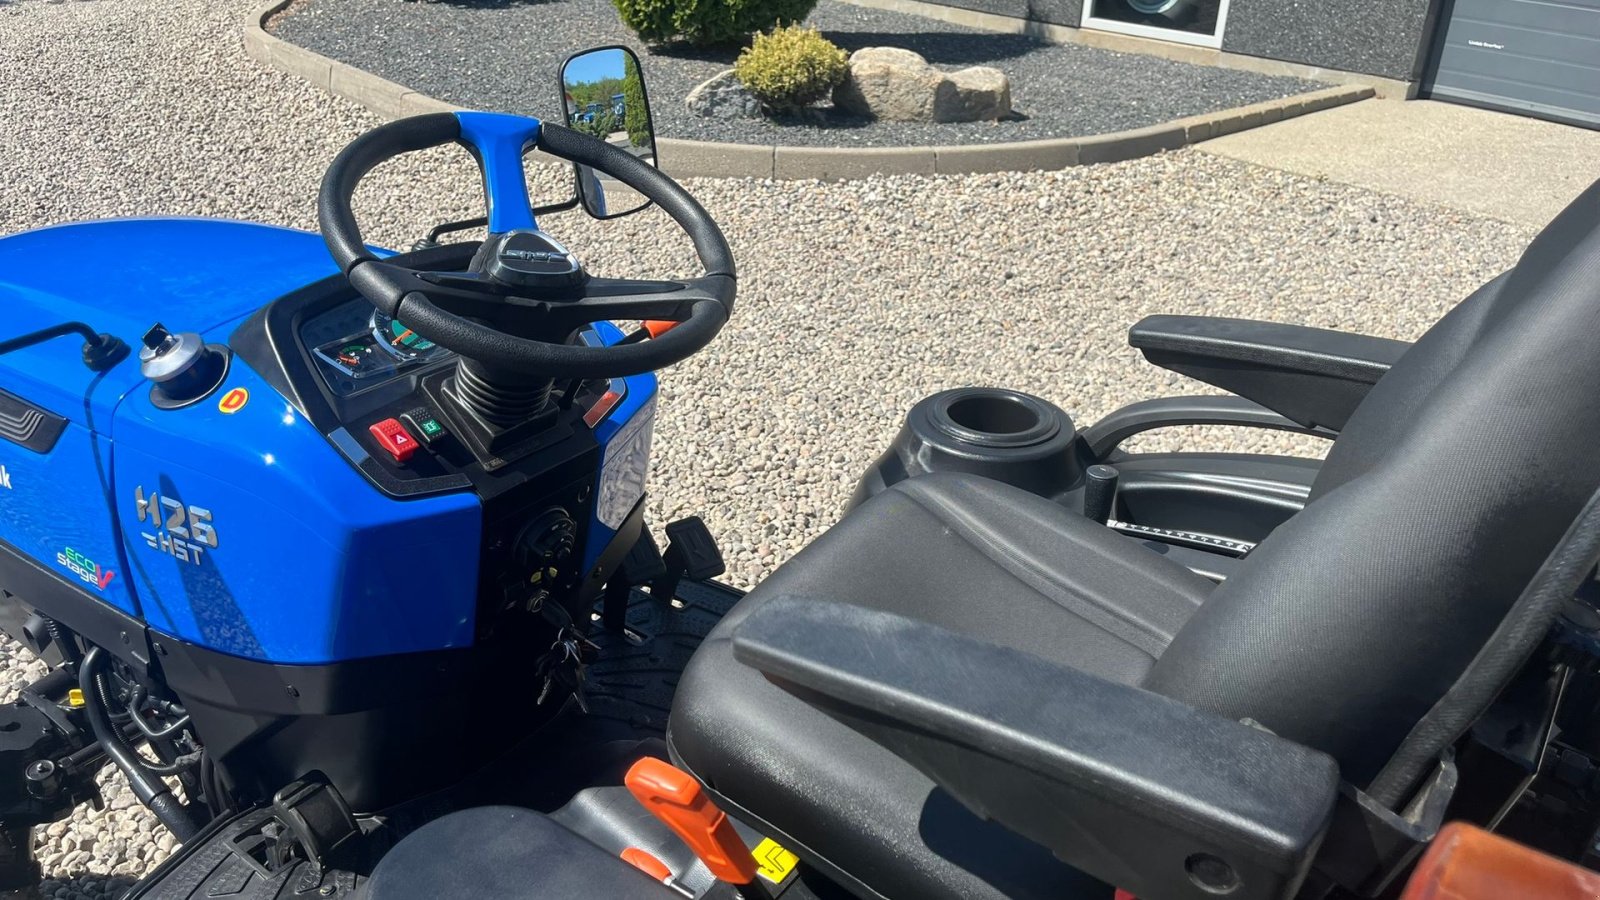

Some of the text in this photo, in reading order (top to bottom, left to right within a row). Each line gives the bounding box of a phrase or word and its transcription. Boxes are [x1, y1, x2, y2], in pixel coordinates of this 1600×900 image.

[222, 390, 246, 409] D
[135, 485, 218, 549] H26
[65, 546, 96, 573] ECO
[158, 531, 203, 566] HST
